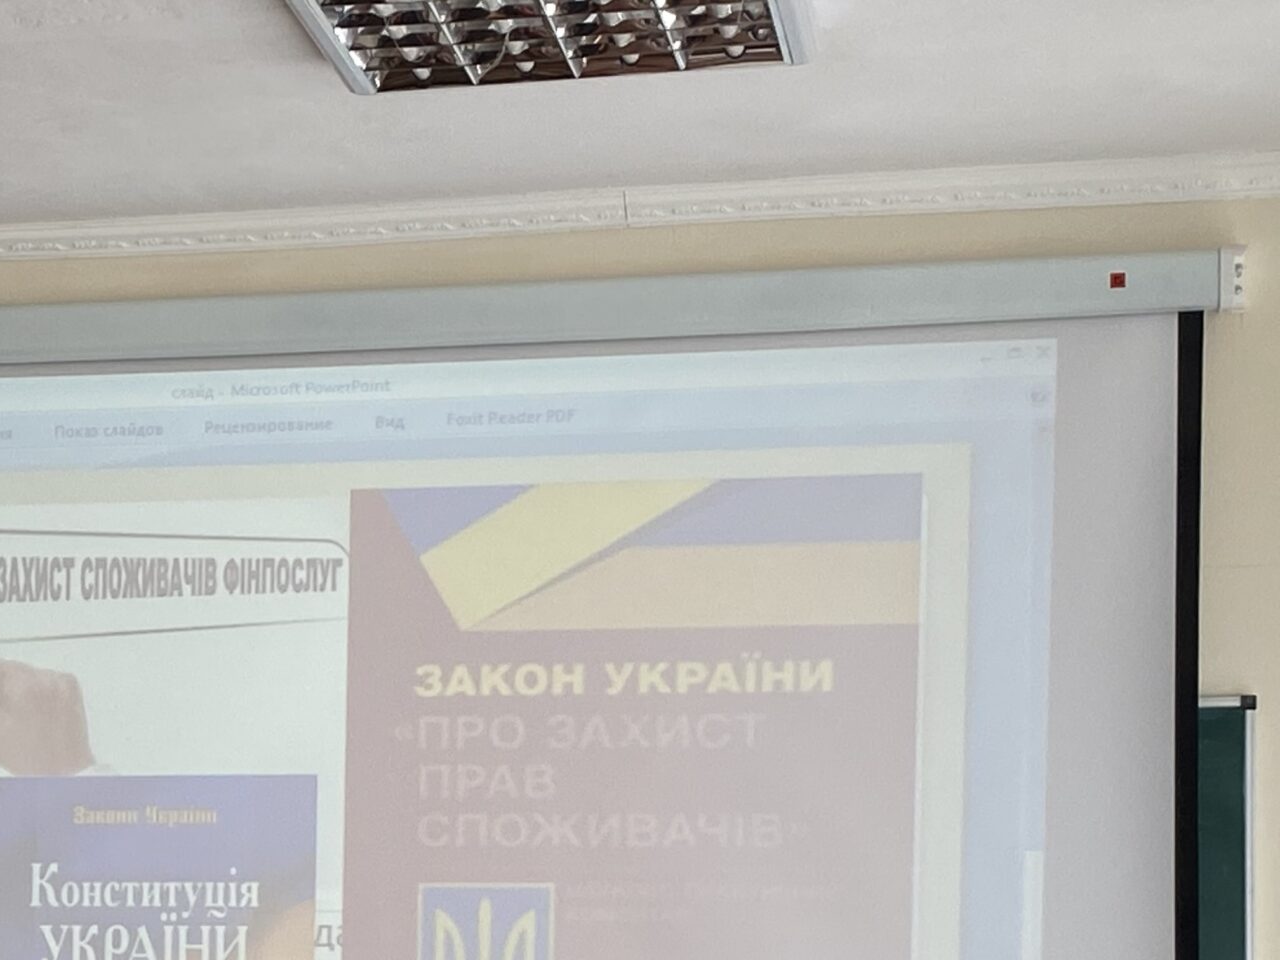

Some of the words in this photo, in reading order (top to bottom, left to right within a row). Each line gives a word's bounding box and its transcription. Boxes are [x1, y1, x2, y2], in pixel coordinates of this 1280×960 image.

[230, 380, 301, 398] Microsoft
[305, 377, 391, 395] PowerPoint
[54, 424, 100, 439] Показ
[103, 421, 164, 438] слайдов
[374, 414, 406, 431] Вид
[487, 409, 542, 426] Reader
[545, 407, 577, 425] PDF
[80, 556, 218, 600] СПОЖИВАЧІВ
[222, 556, 343, 595] ФІНПОСЛУГ
[414, 662, 586, 698] ЗАКОН
[604, 650, 836, 695] УКРАЇНИ
[546, 711, 768, 750] ЗАХИСТ
[419, 763, 557, 801] ПРАВ
[29, 861, 261, 919] Конституція
